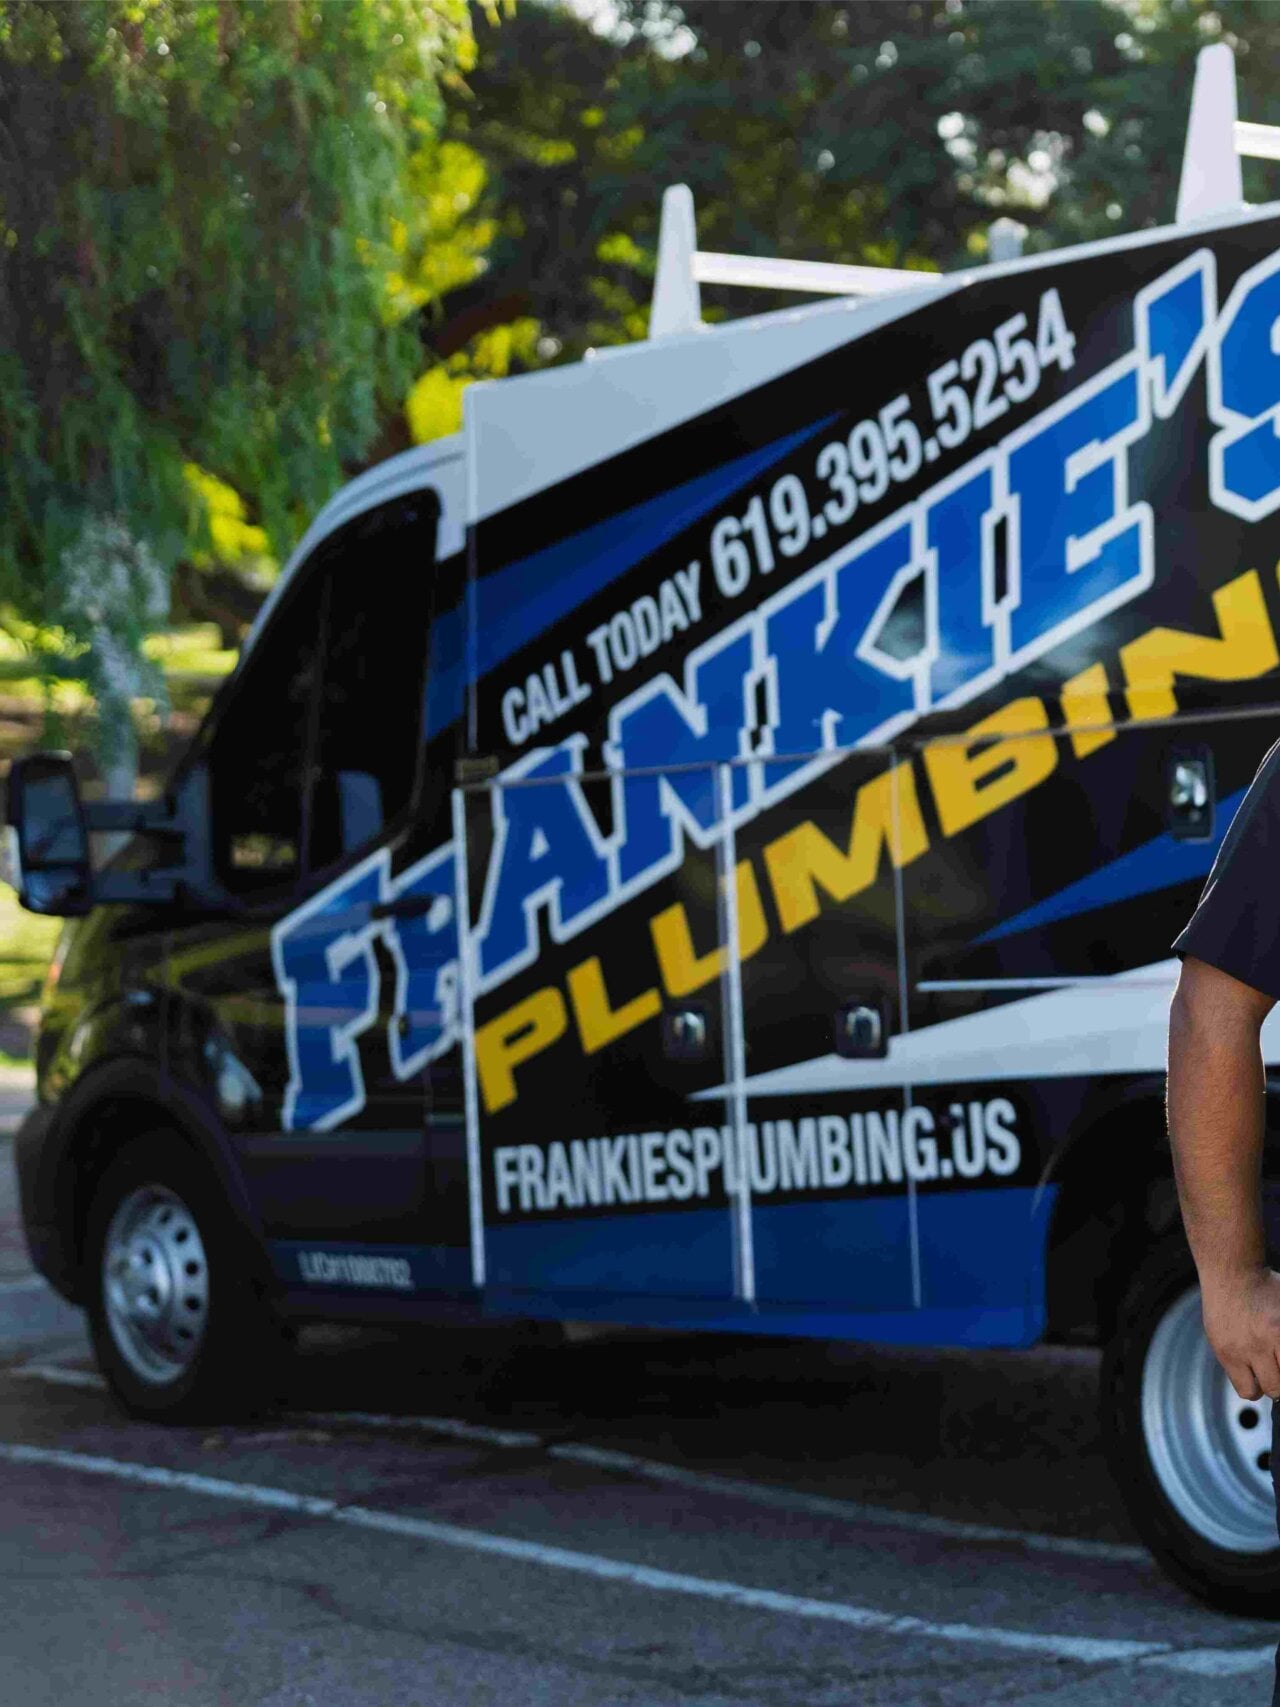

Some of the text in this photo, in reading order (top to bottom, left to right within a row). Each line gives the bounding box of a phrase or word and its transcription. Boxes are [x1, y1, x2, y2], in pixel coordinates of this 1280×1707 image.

[502, 287, 1076, 744] CALL TODAY 619.395.5254
[494, 1098, 1021, 1214] FRANKIESPLUMBING.US
